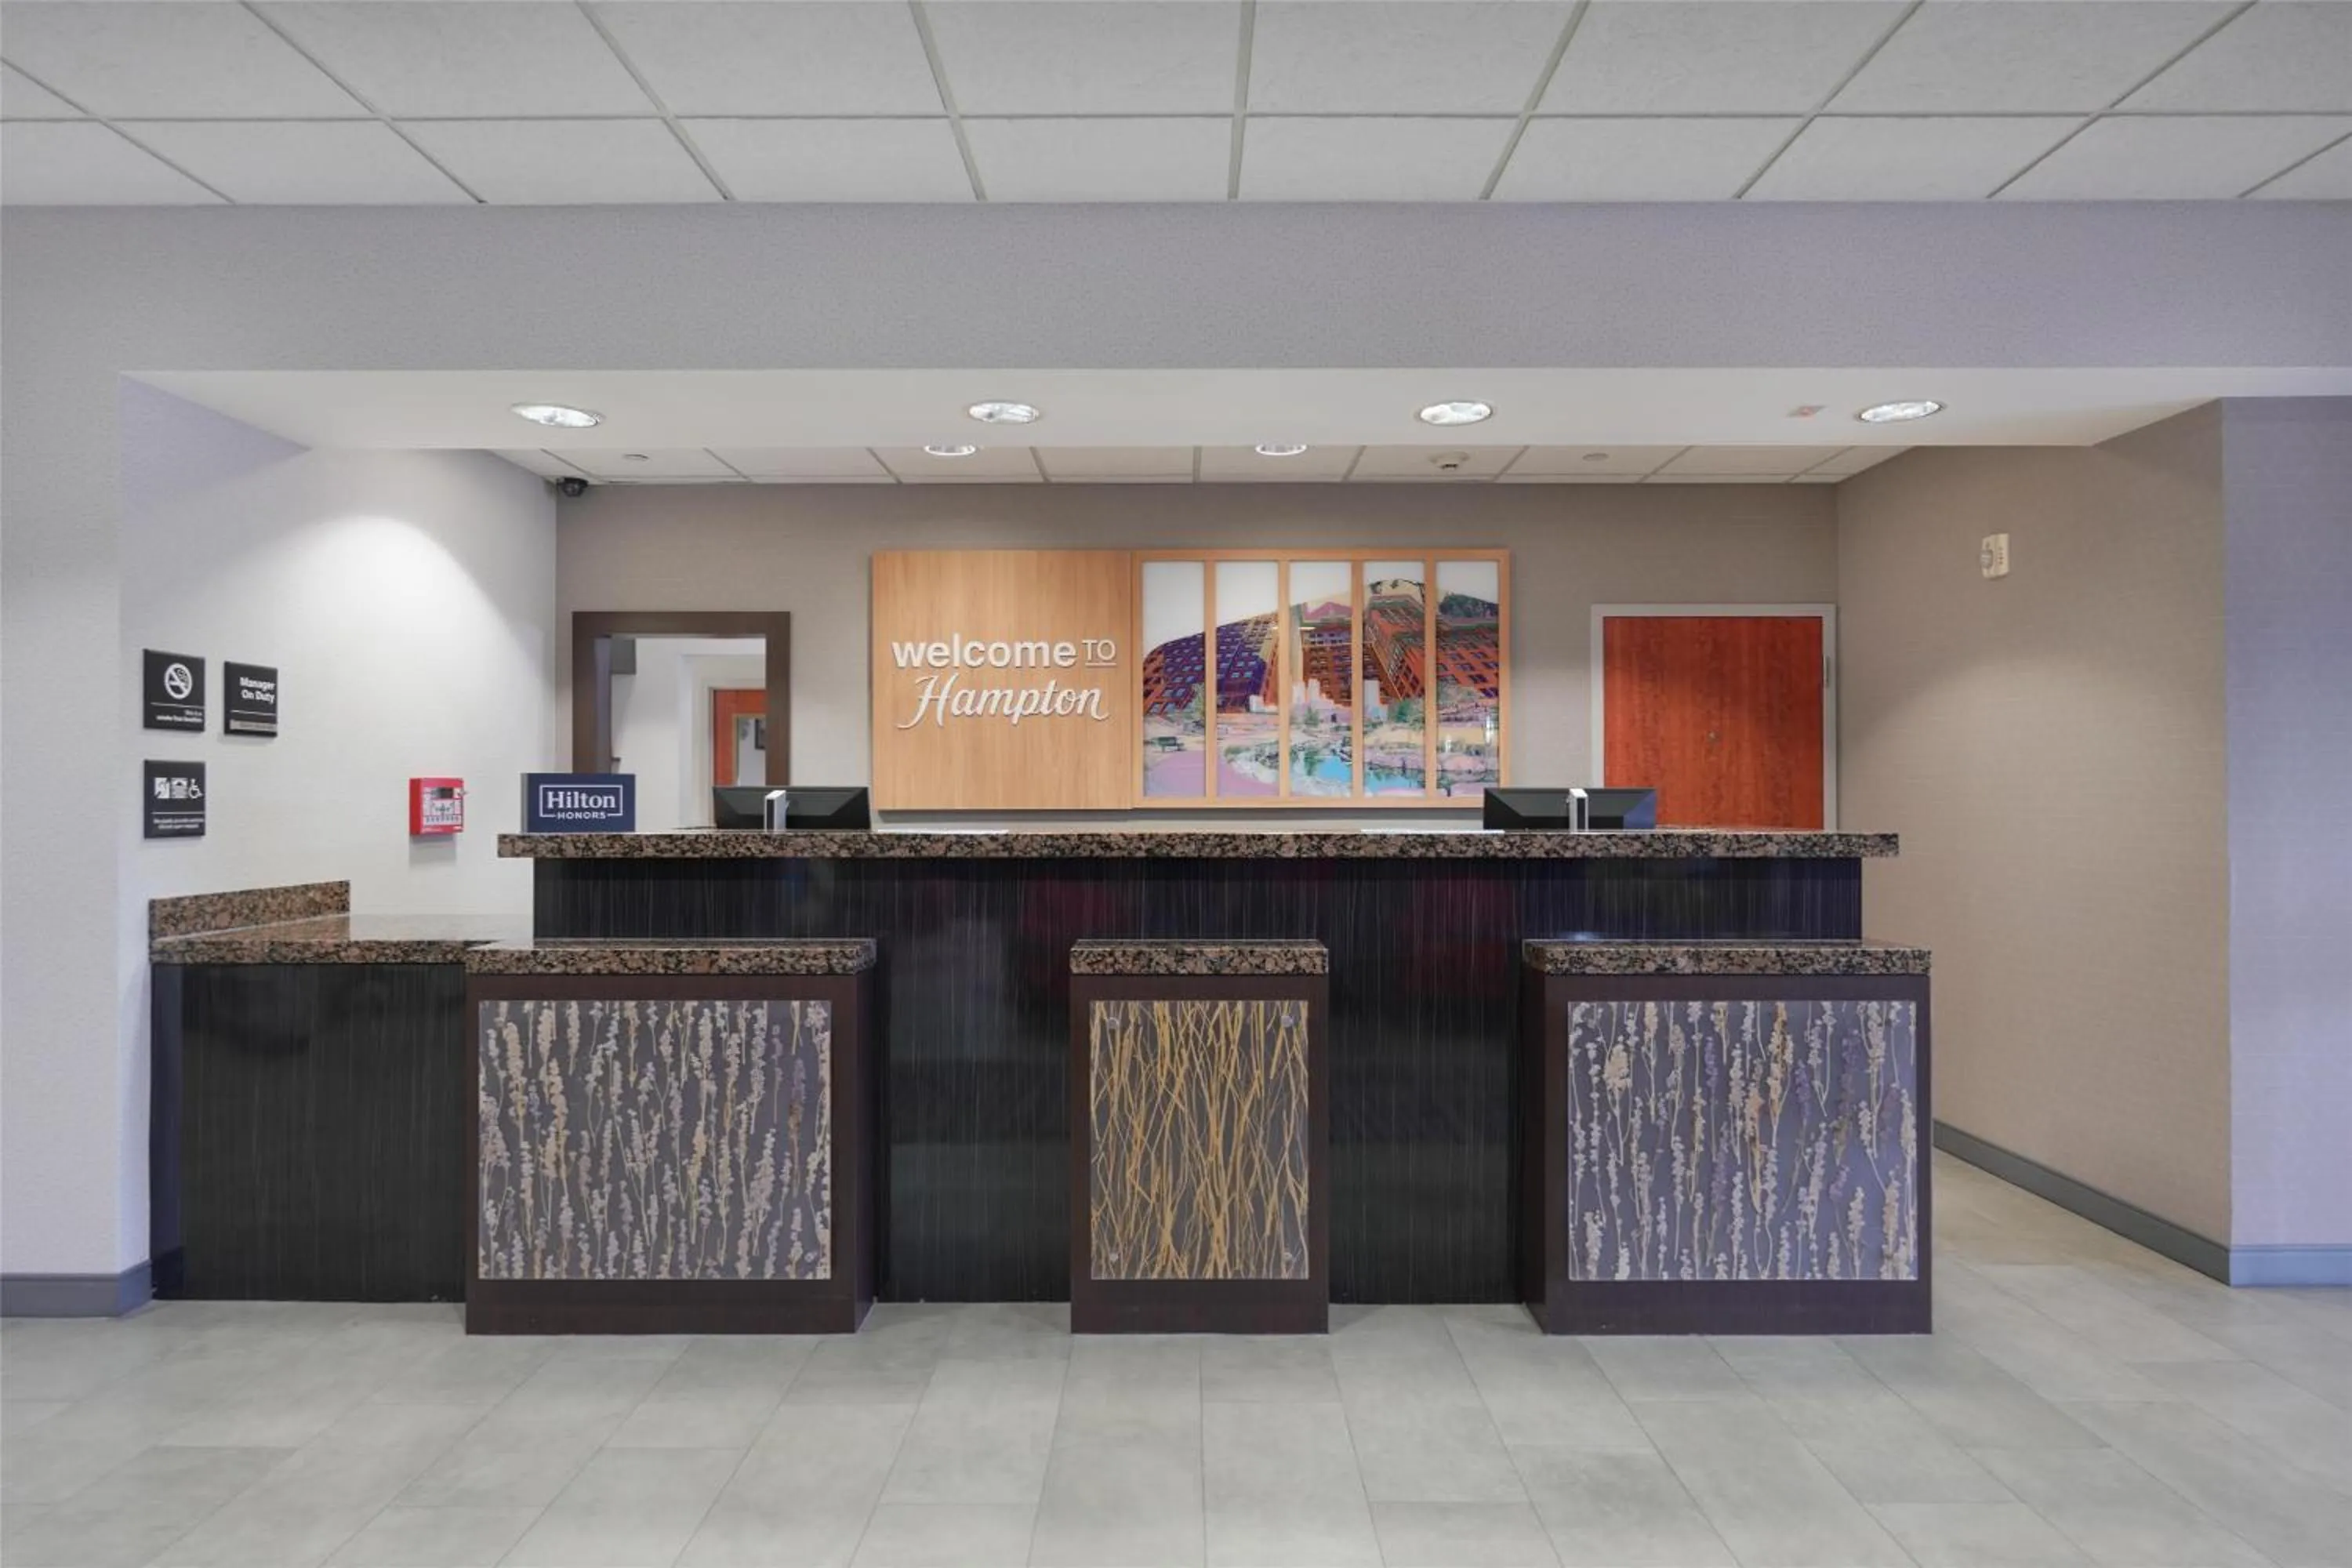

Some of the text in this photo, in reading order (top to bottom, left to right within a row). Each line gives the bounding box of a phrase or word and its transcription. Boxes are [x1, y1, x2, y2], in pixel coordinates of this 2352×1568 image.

[891, 633, 1116, 667] welcome TO
[240, 677, 275, 691] Manager
[241, 689, 275, 704] On Duty
[895, 673, 1110, 729] Hampton
[547, 791, 615, 808] Hilton
